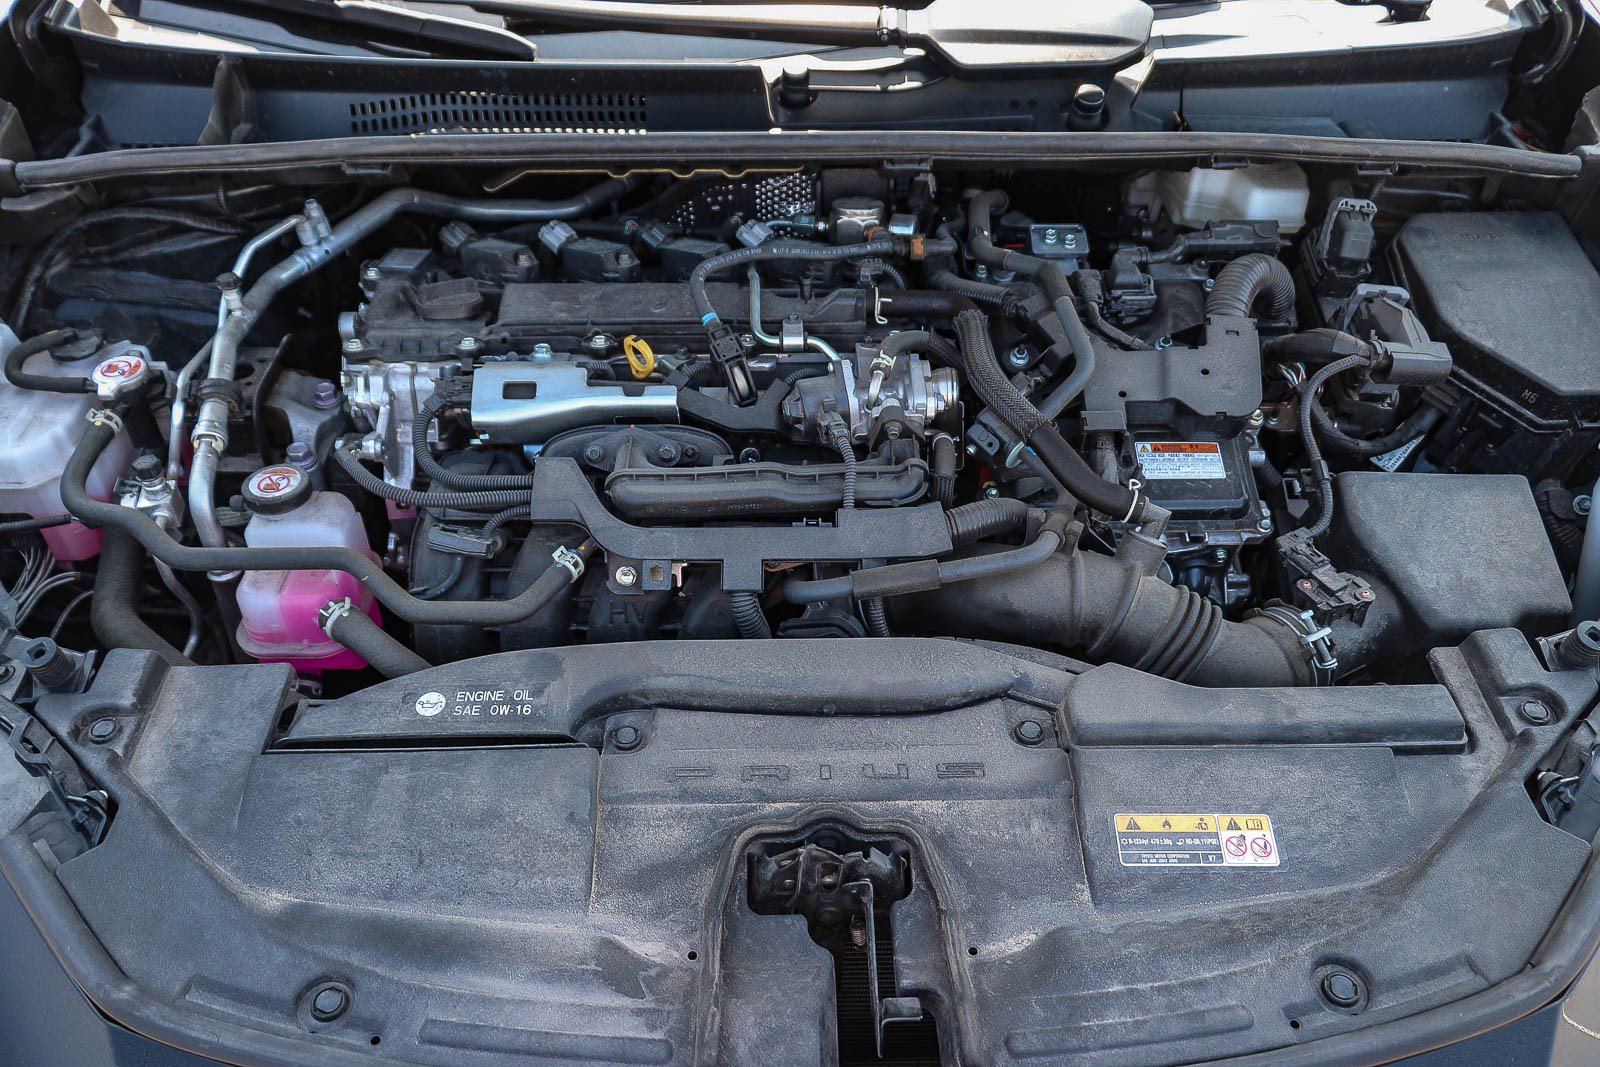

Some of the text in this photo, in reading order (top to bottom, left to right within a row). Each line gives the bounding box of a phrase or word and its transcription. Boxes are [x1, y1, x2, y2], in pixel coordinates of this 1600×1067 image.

[456, 689, 534, 702] ENGINE OIL
[453, 704, 532, 716] SAE 0W-16
[666, 762, 985, 782] PRIUS
